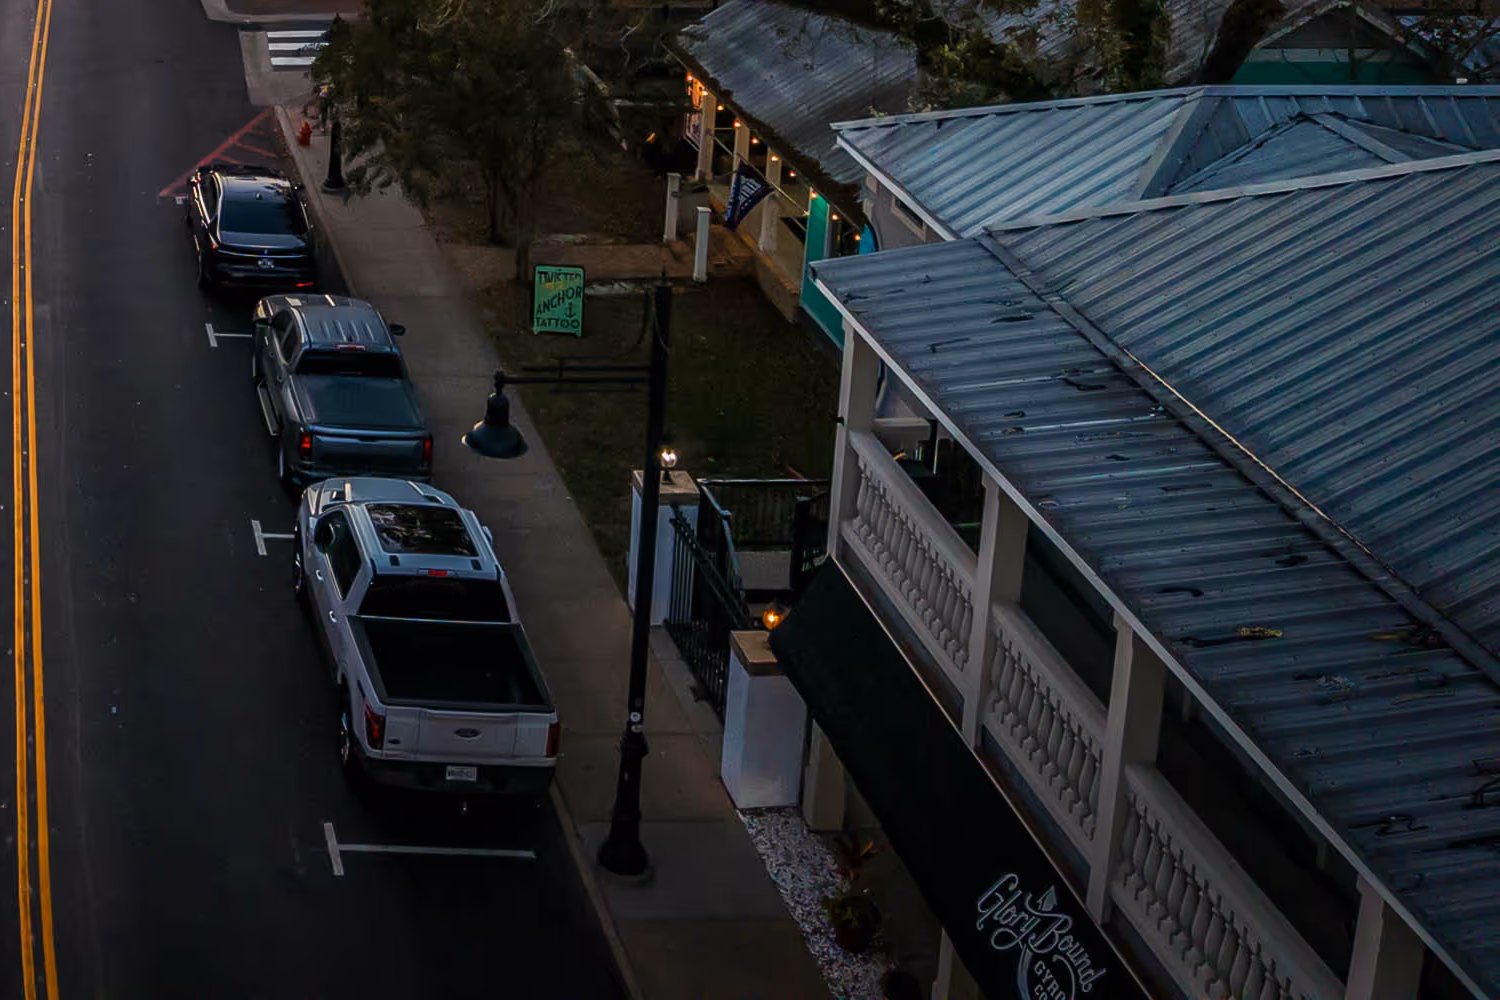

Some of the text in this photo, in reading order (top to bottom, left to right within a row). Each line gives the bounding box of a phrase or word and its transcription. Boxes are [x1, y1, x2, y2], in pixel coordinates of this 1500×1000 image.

[536, 286, 582, 314] ANCHOR
[536, 317, 580, 329] TATTOO
[976, 873, 1107, 993] Glory Bound
